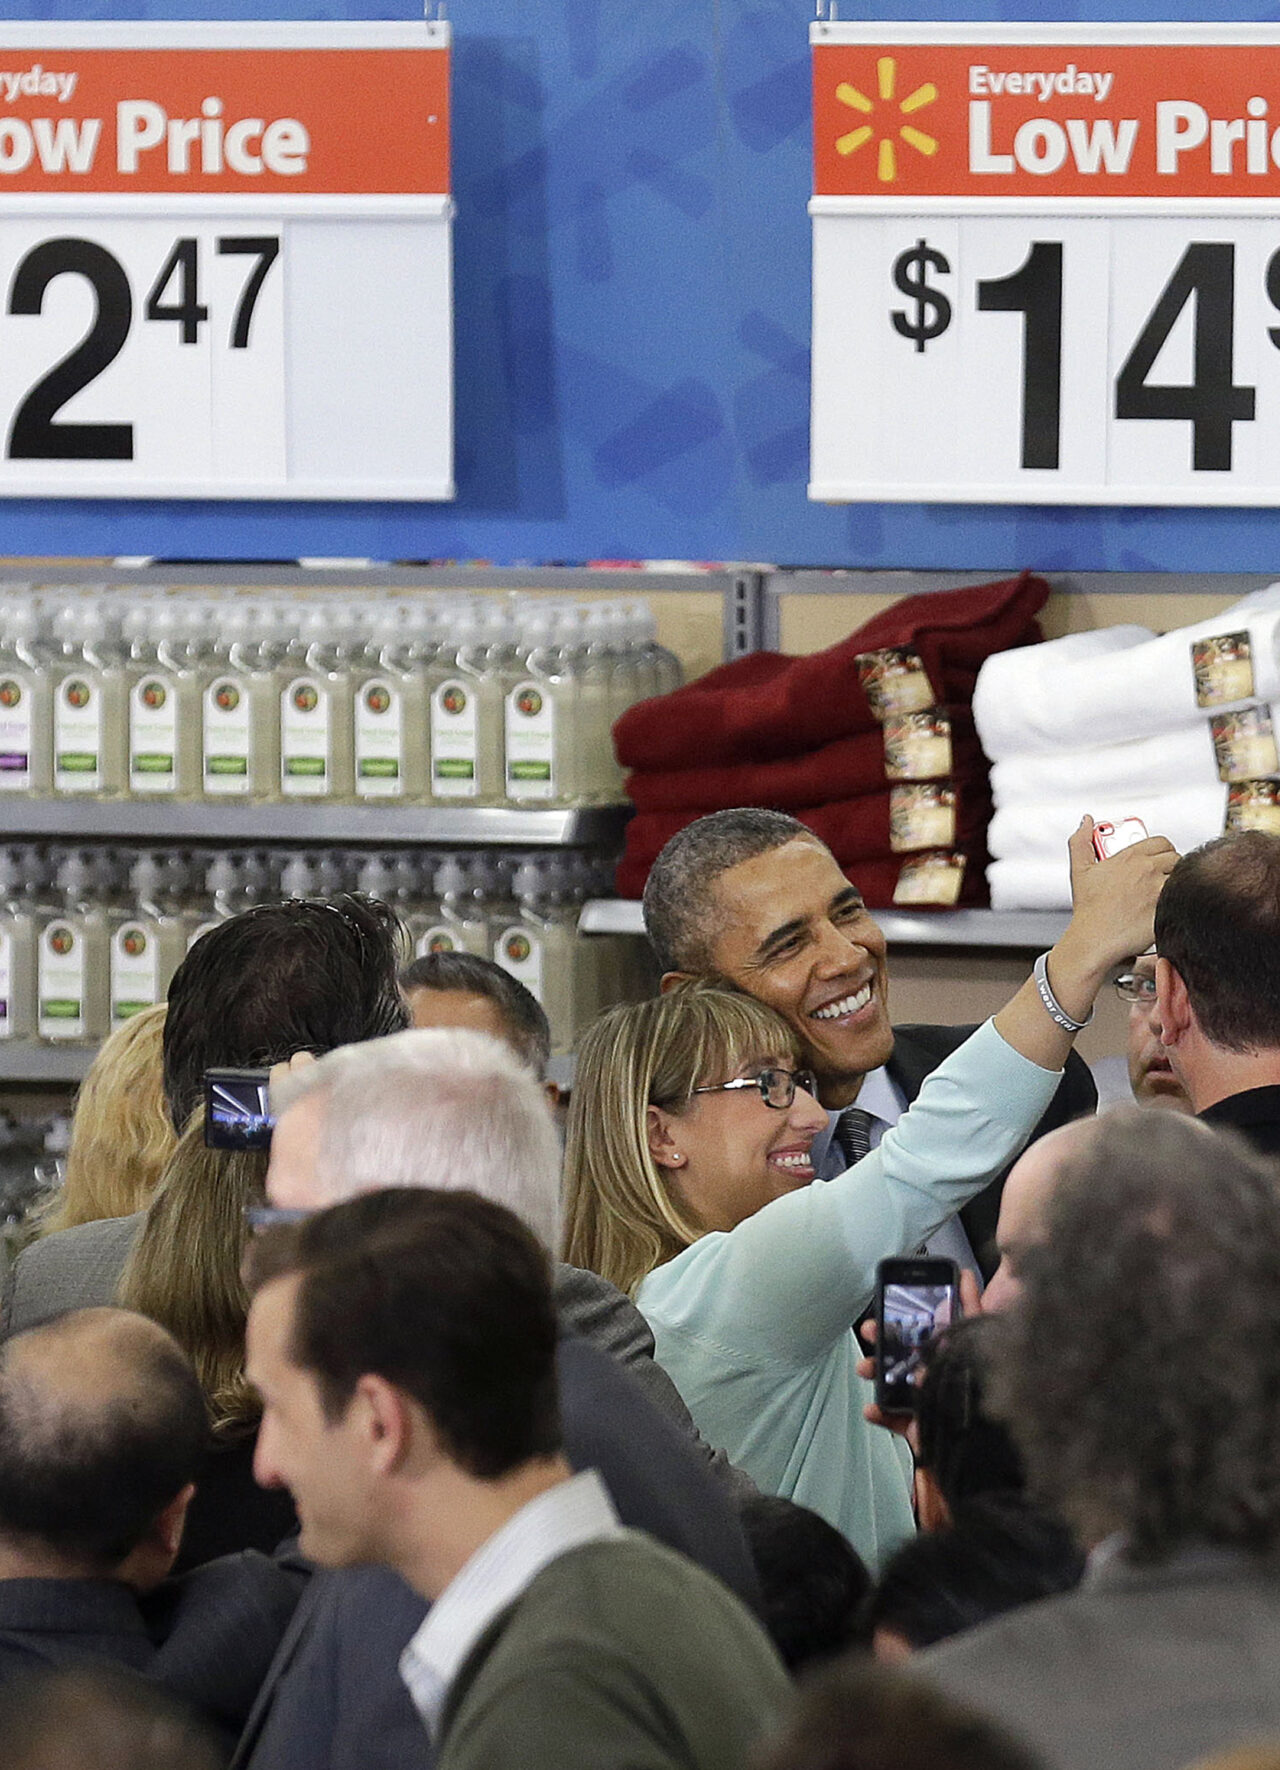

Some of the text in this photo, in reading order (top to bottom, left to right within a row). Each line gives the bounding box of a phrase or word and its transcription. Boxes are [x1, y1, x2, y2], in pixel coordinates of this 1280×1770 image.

[0, 64, 78, 102] ryday
[969, 64, 1113, 102] Everyday
[0, 96, 311, 175] ow Price
[969, 100, 1139, 175] Low
[1040, 984, 1057, 1012] wear
[1054, 1014, 1077, 1031] gray
